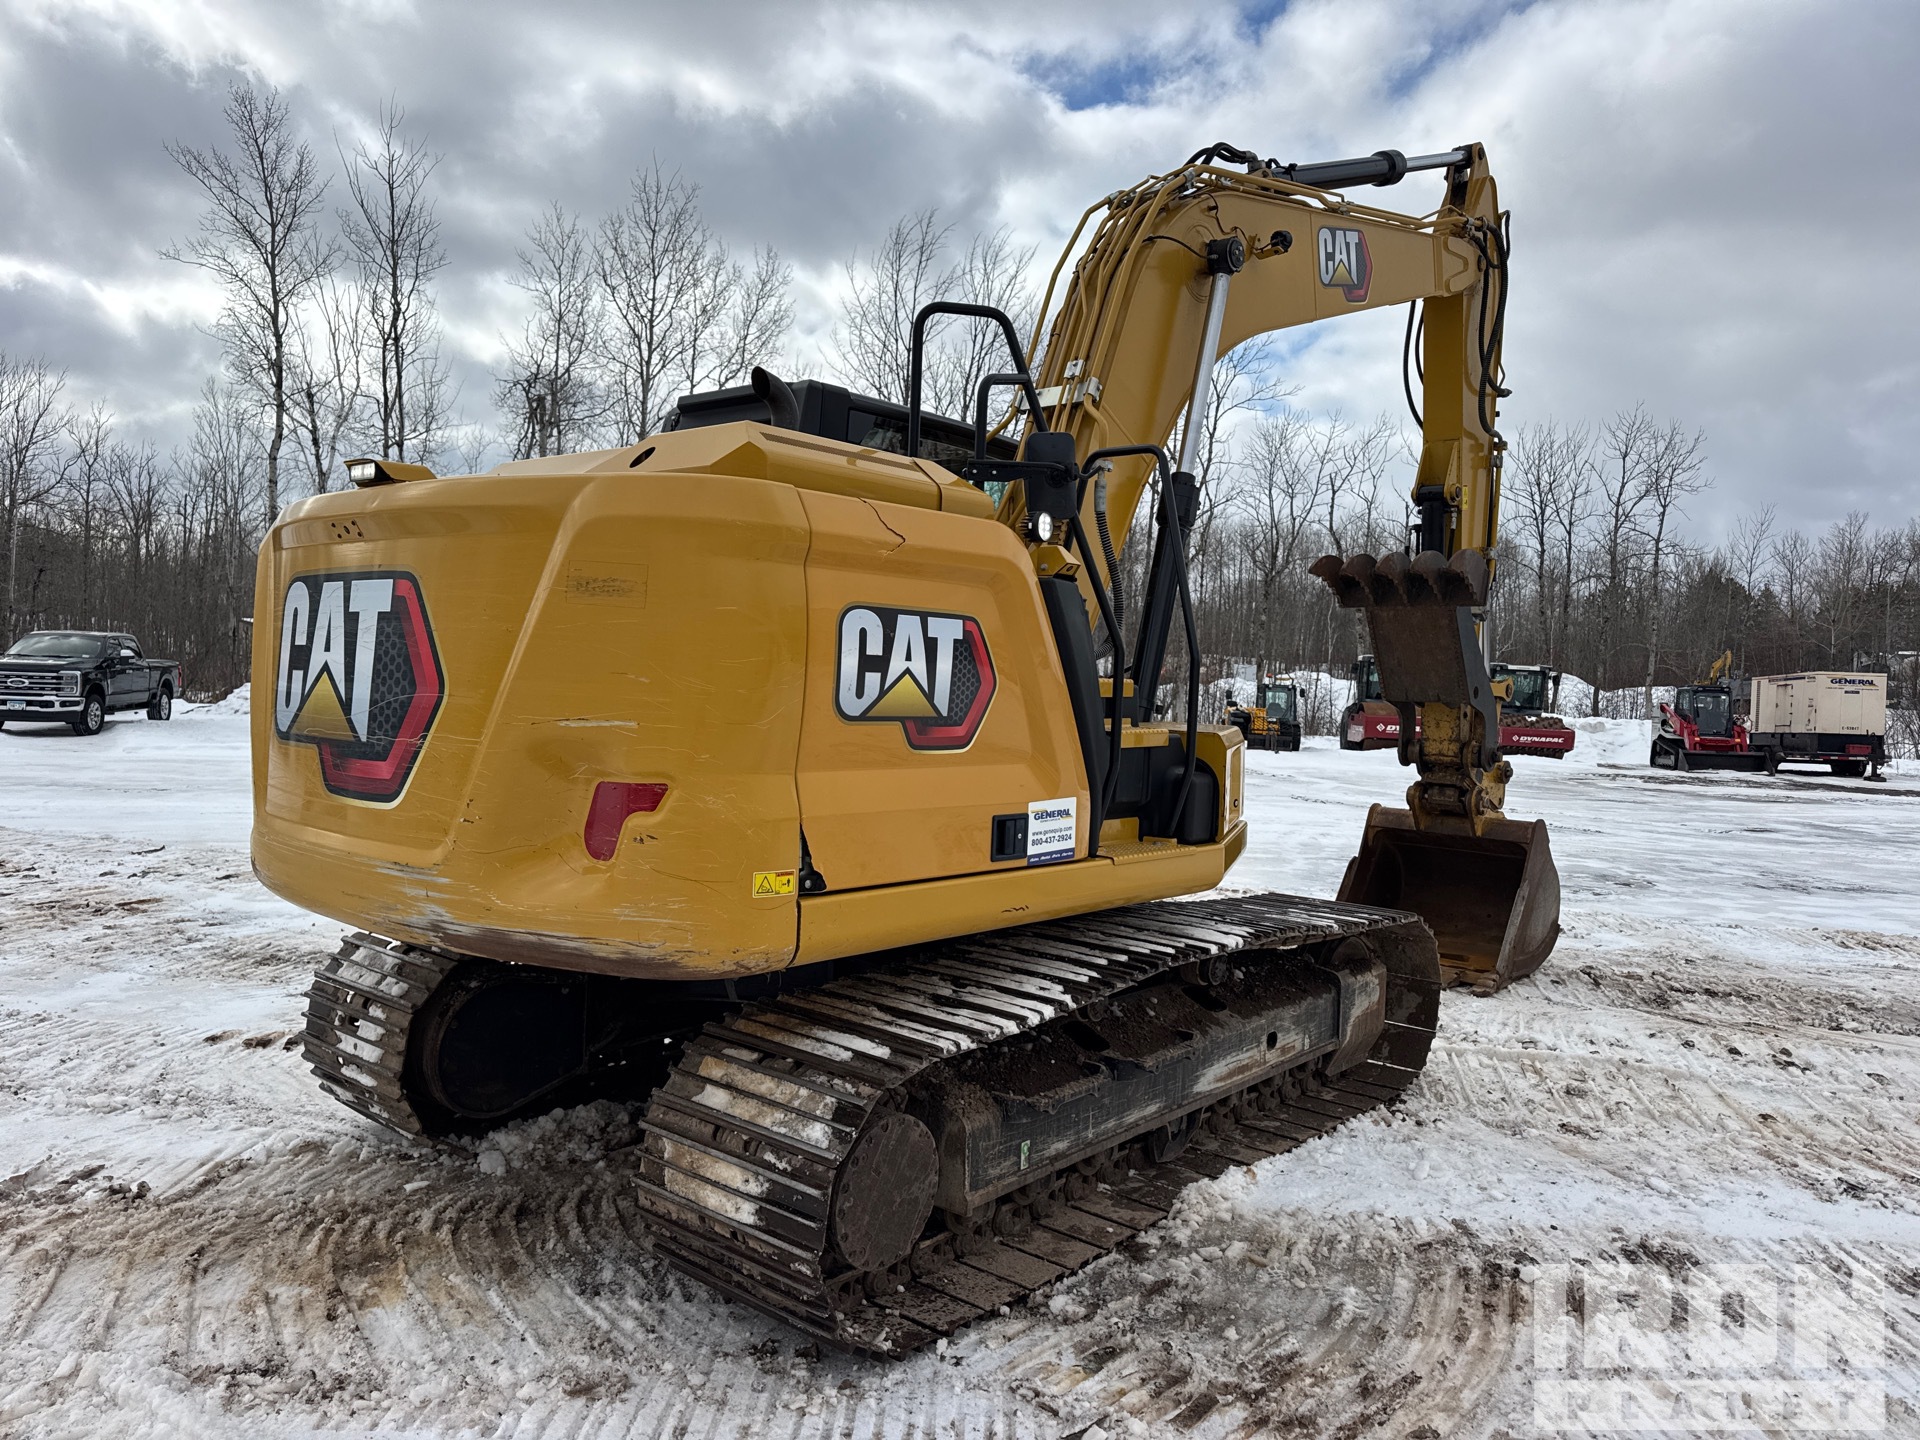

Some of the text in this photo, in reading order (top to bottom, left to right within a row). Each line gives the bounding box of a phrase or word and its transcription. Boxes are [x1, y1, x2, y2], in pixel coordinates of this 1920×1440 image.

[1319, 228, 1358, 284] CAT
[276, 578, 394, 742] CAT
[839, 608, 963, 716] CAT
[1519, 735, 1565, 743] DYNAPAC
[1034, 808, 1071, 820] GENERAL
[1032, 826, 1072, 837] www.genequip.com
[1031, 834, 1072, 846] 800-437-2924
